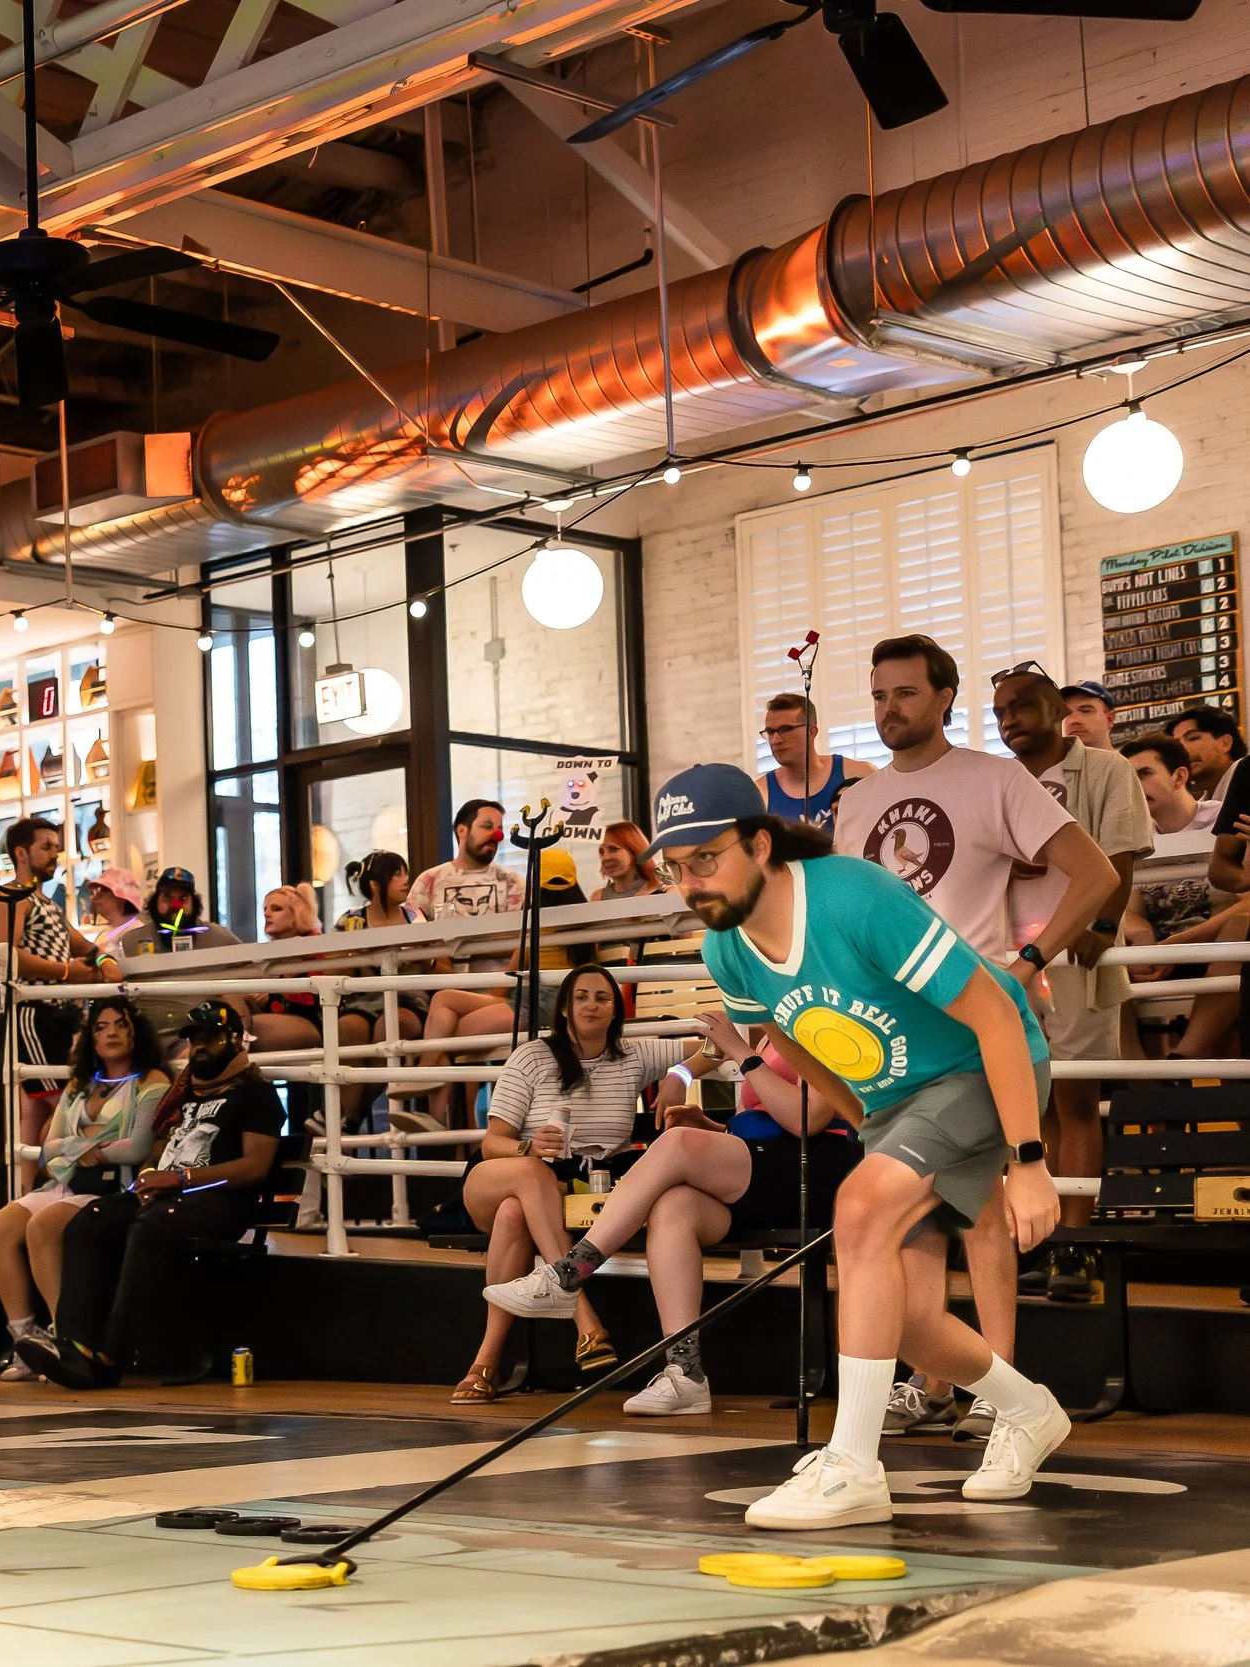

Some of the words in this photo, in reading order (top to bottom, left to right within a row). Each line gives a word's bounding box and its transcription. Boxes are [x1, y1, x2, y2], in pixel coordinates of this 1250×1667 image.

[1182, 542, 1229, 555] Division
[1158, 565, 1187, 584] LINES
[1219, 558, 1227, 571] 1
[1217, 576, 1227, 590] 2
[1219, 597, 1230, 610] 2
[1219, 616, 1230, 630] 2
[1219, 635, 1230, 649] 3
[1219, 655, 1230, 669] 3
[1219, 674, 1230, 688] 4
[42, 686, 54, 716] 0
[556, 760, 593, 769] DOWN
[597, 759, 612, 768] TO
[877, 804, 937, 835] KHAKI
[542, 826, 602, 840] COWN
[773, 985, 814, 1027] SHUFF
[821, 986, 841, 1006] IT
[847, 1000, 897, 1036] REAL
